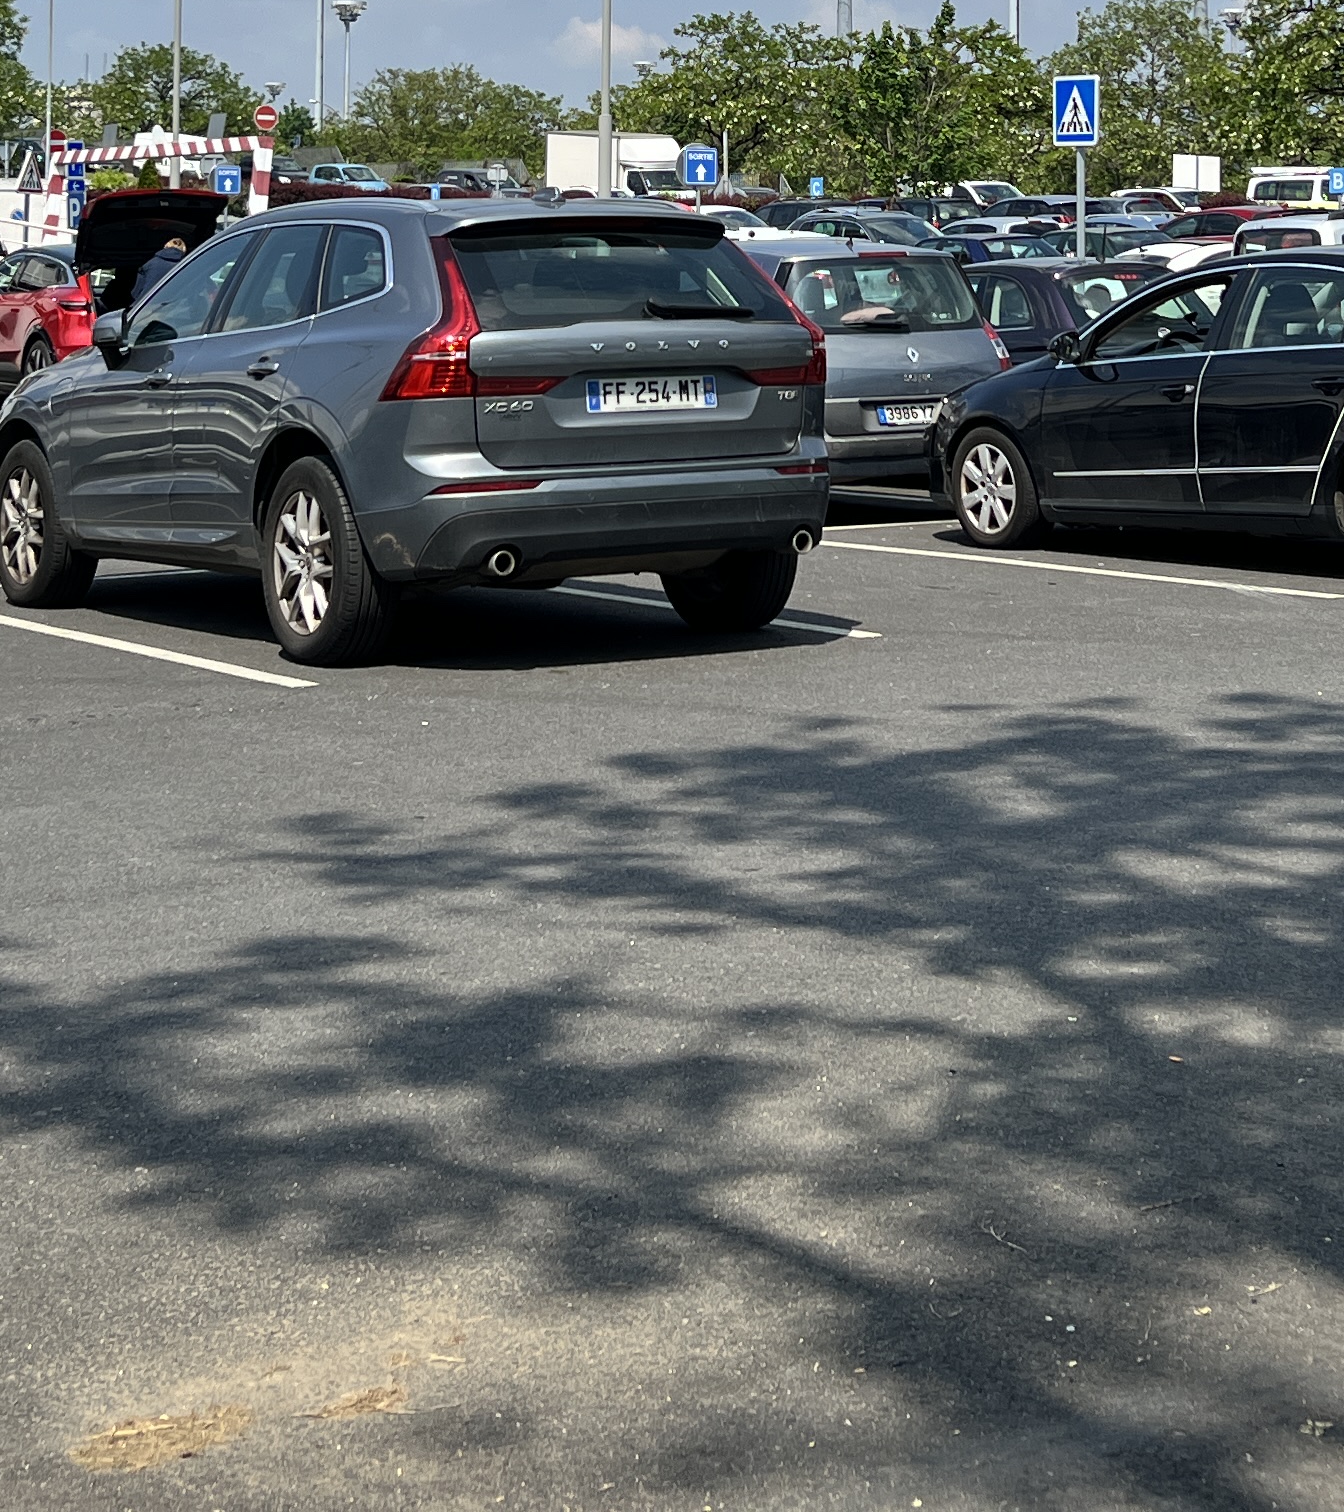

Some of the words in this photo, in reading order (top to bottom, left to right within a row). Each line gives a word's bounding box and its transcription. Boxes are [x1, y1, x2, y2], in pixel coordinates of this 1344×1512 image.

[688, 152, 714, 161] SORTIE
[812, 181, 822, 196] C
[1333, 172, 1344, 190] B
[69, 197, 81, 228] P
[590, 339, 729, 351] VOLVO
[602, 379, 701, 405] FF-254-MT
[484, 400, 534, 414] XC60
